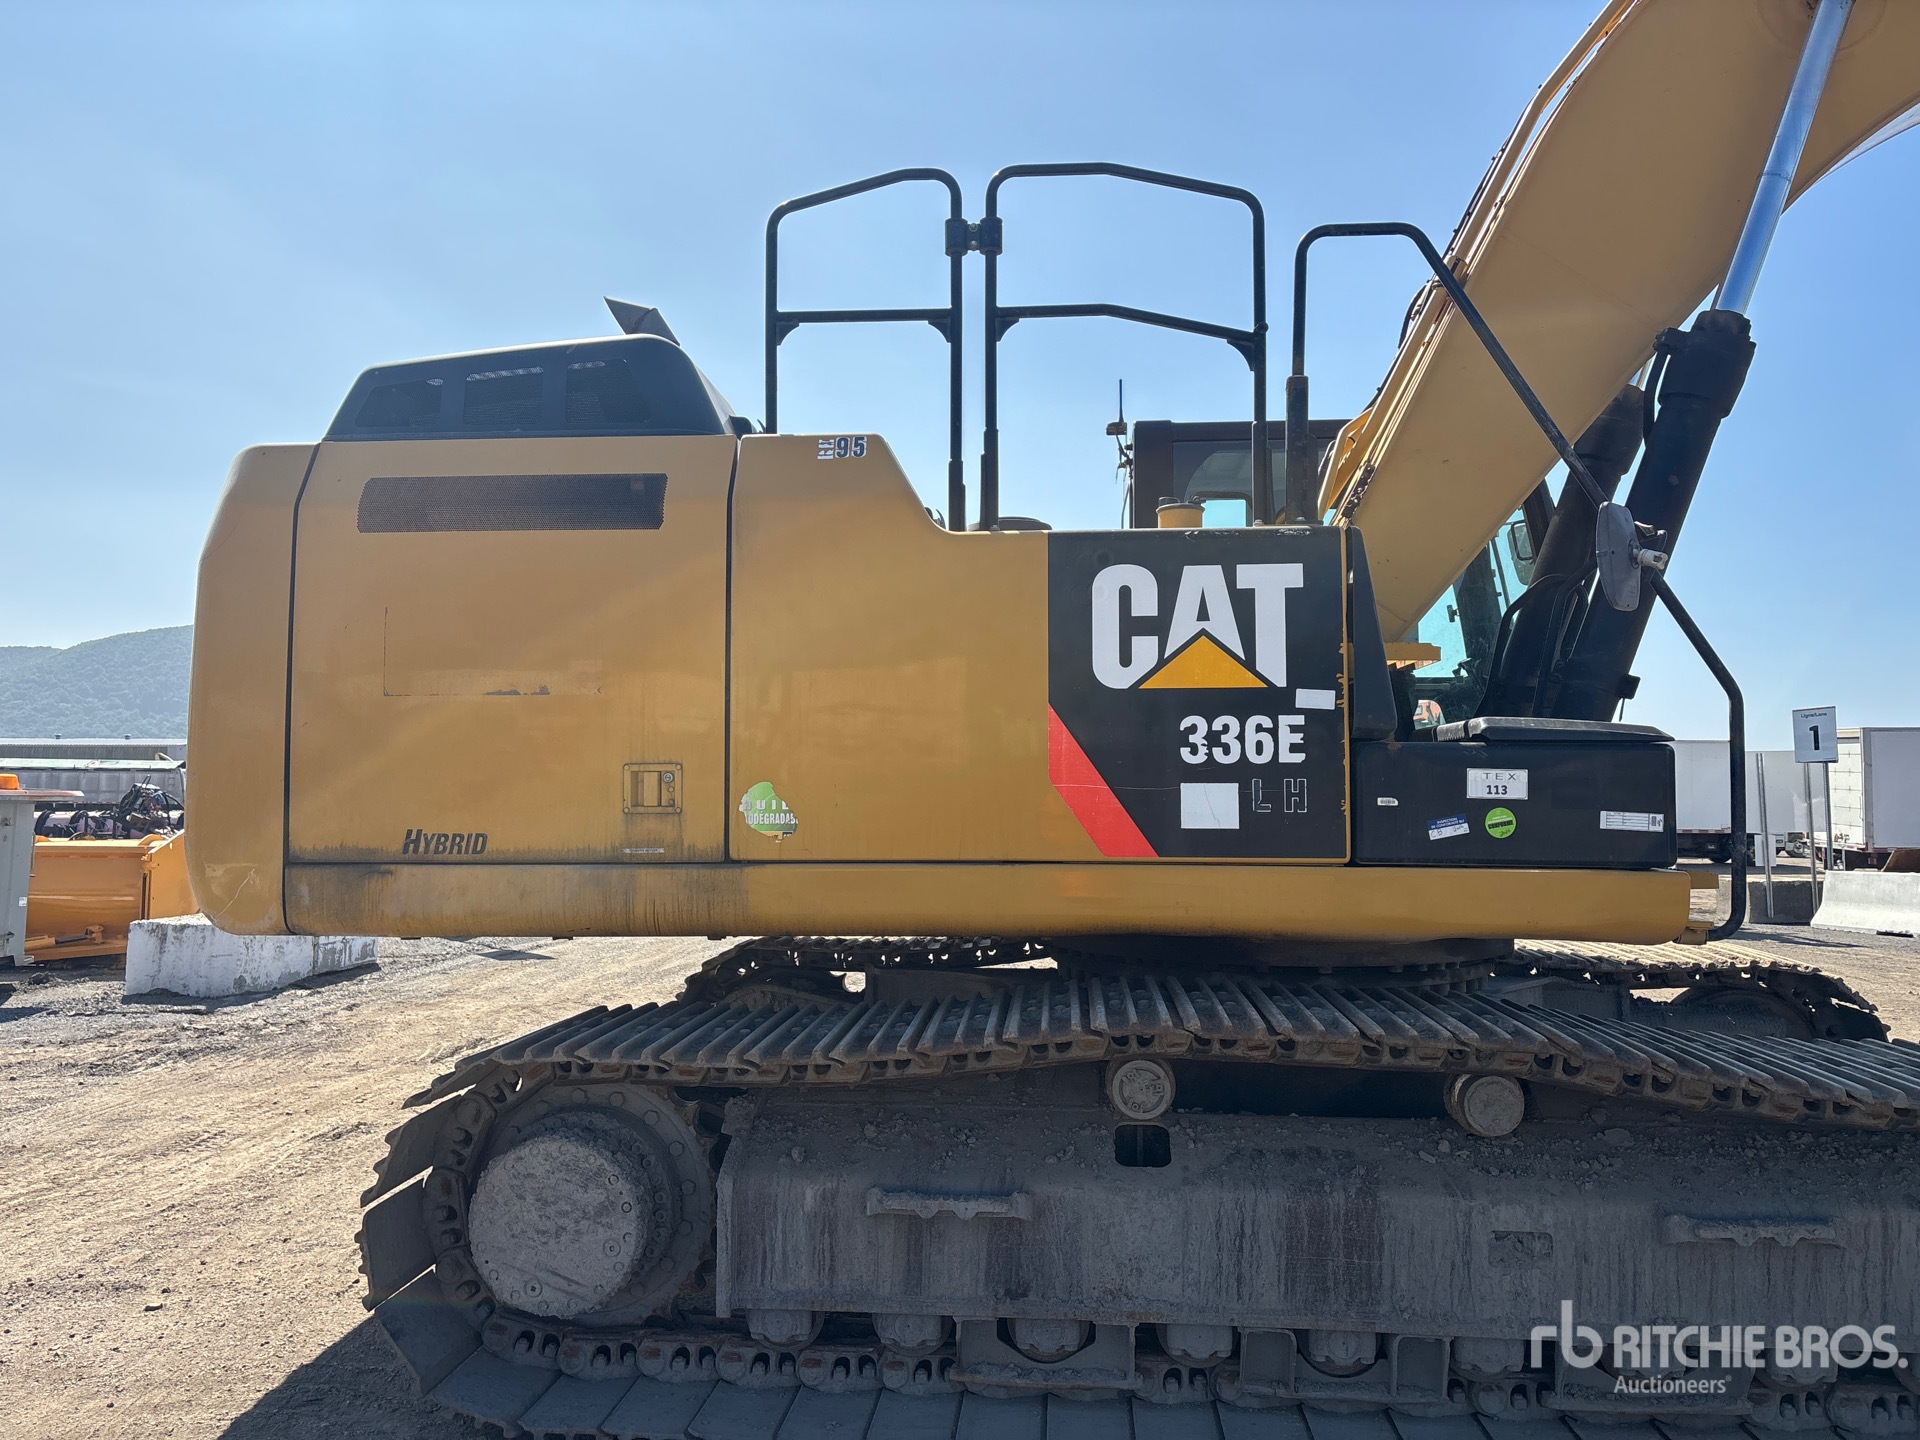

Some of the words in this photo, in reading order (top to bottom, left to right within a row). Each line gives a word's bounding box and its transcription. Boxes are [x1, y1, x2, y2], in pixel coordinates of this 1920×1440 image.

[835, 436, 867, 458] 95
[1092, 563, 1304, 689] CAT
[1179, 715, 1306, 764] 336E
[1809, 725, 1820, 750] 1
[1486, 785, 1508, 795] 113
